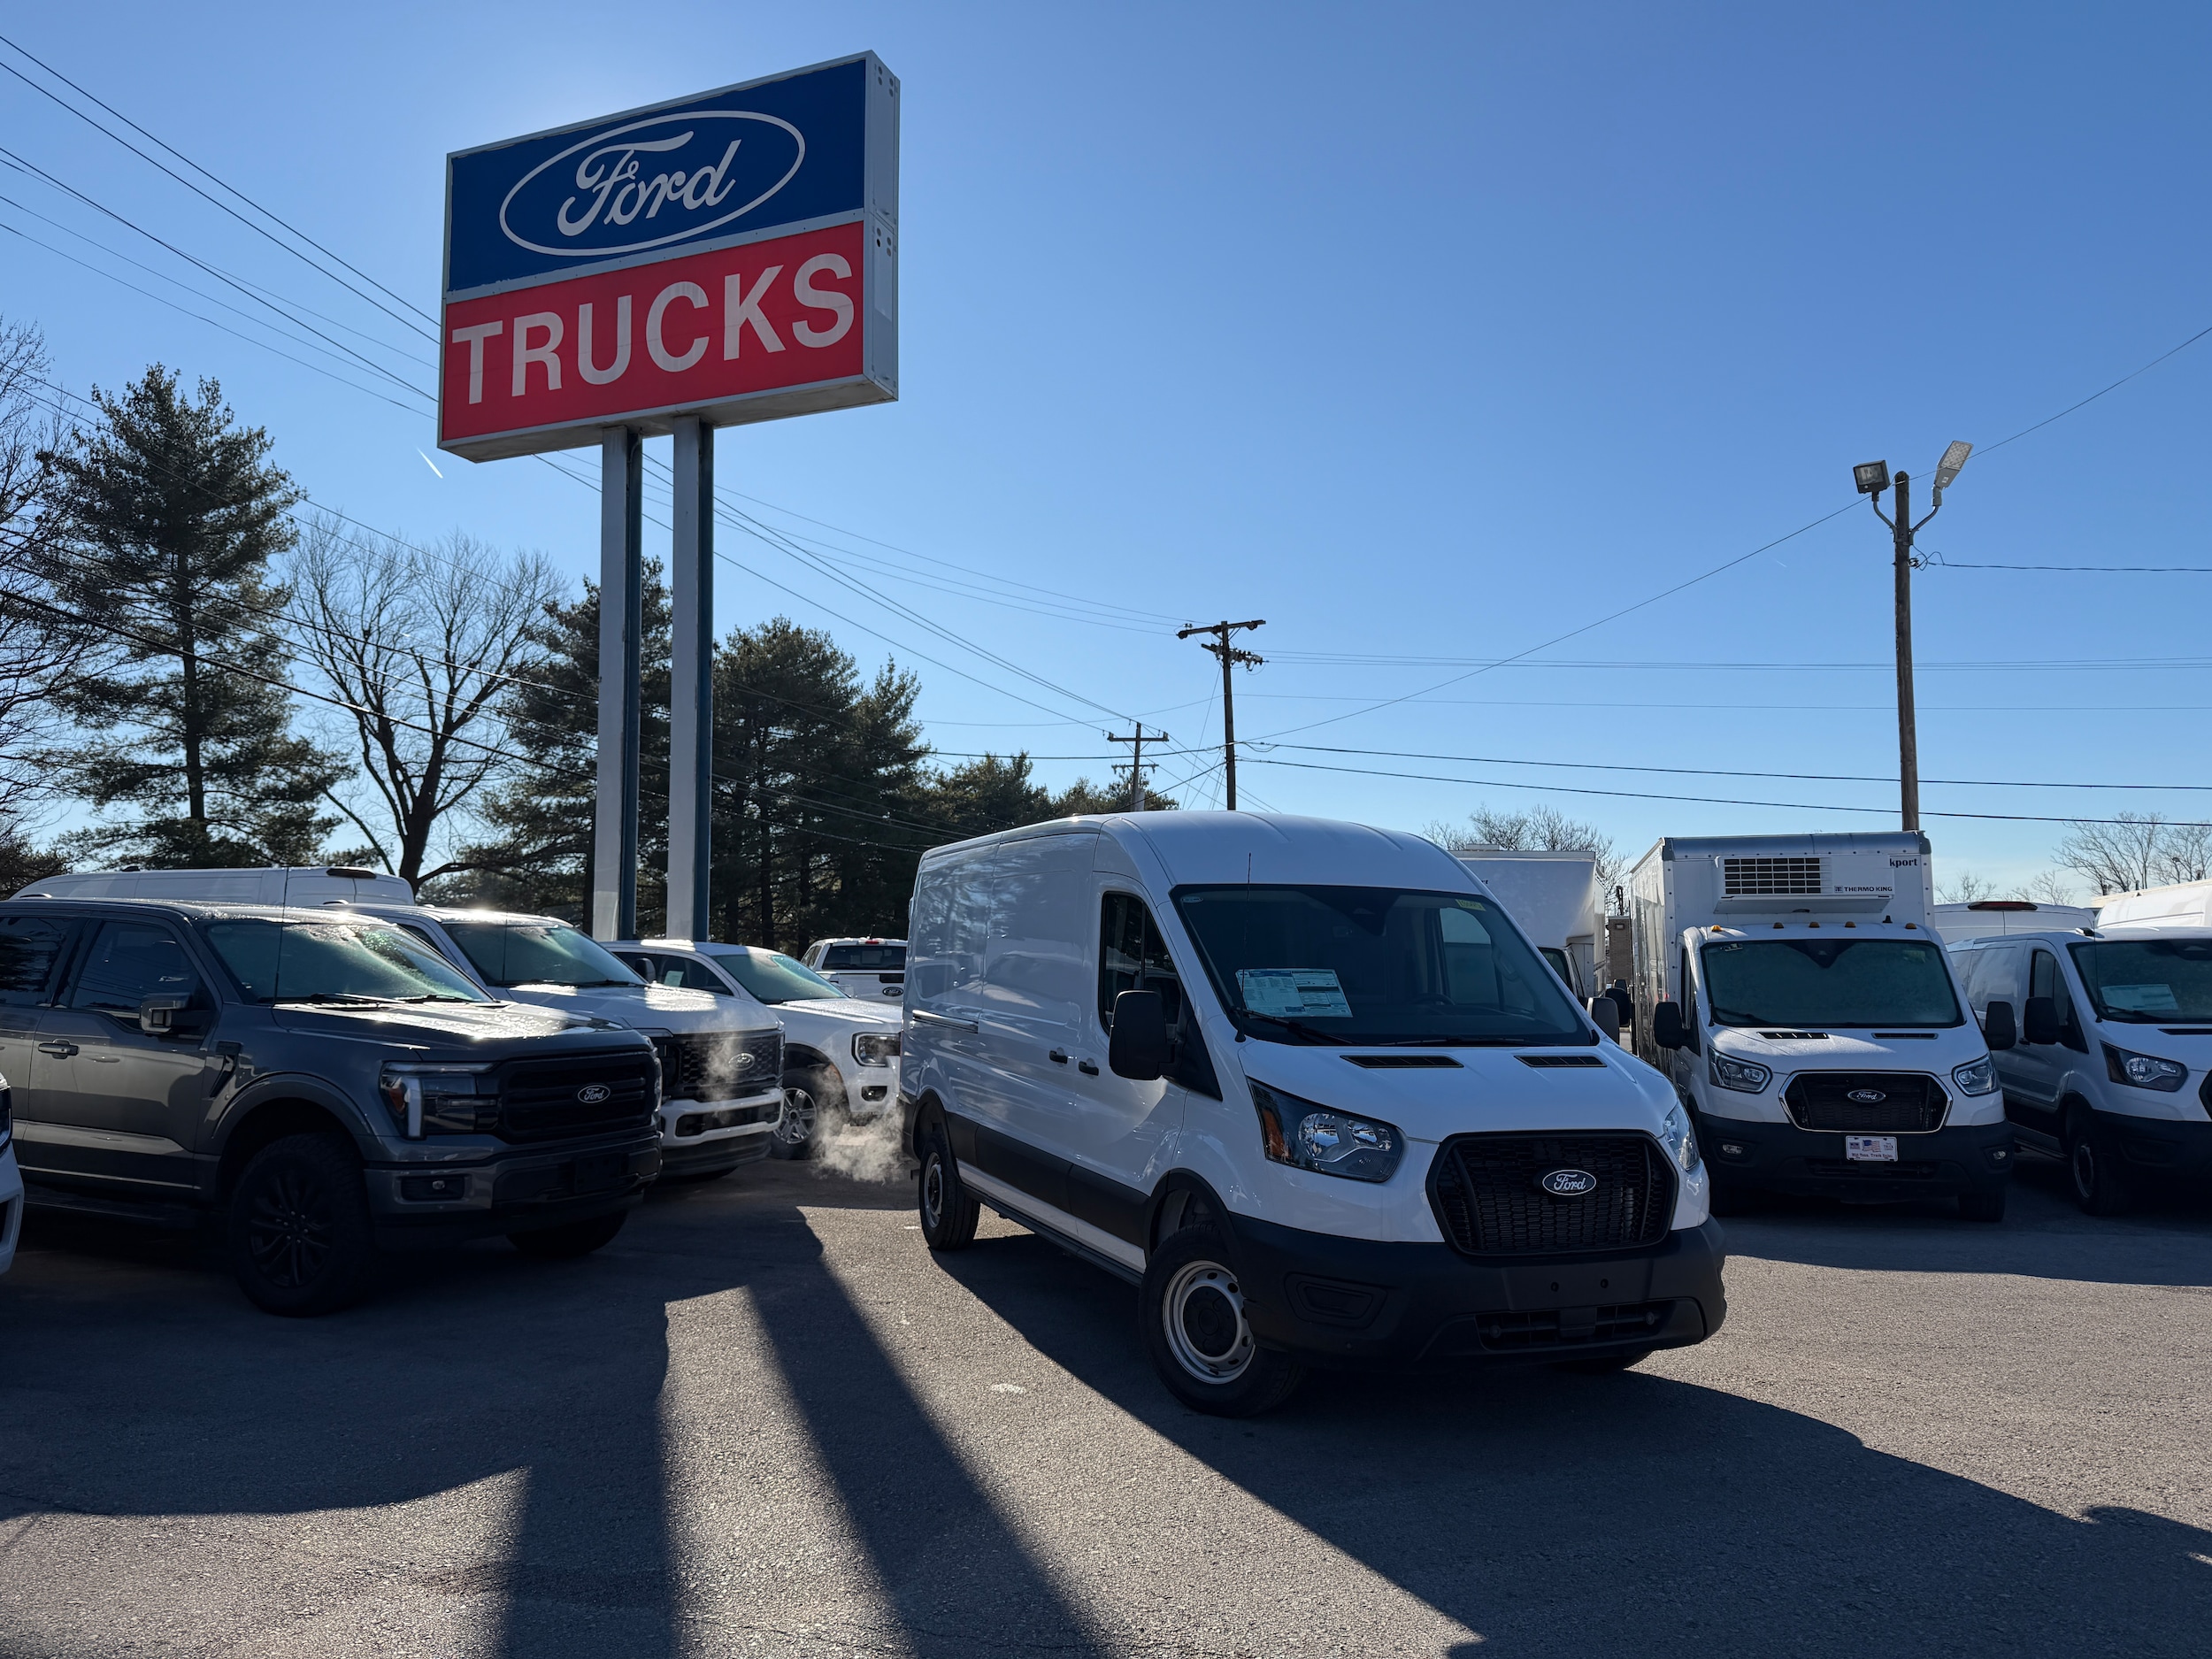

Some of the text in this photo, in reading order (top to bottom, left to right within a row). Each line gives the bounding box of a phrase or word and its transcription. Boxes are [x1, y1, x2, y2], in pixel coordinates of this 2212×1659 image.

[557, 130, 741, 236] Ford
[451, 253, 855, 405] TRUCKS
[583, 1087, 605, 1101] Ford
[1553, 1173, 1586, 1191] Ford
